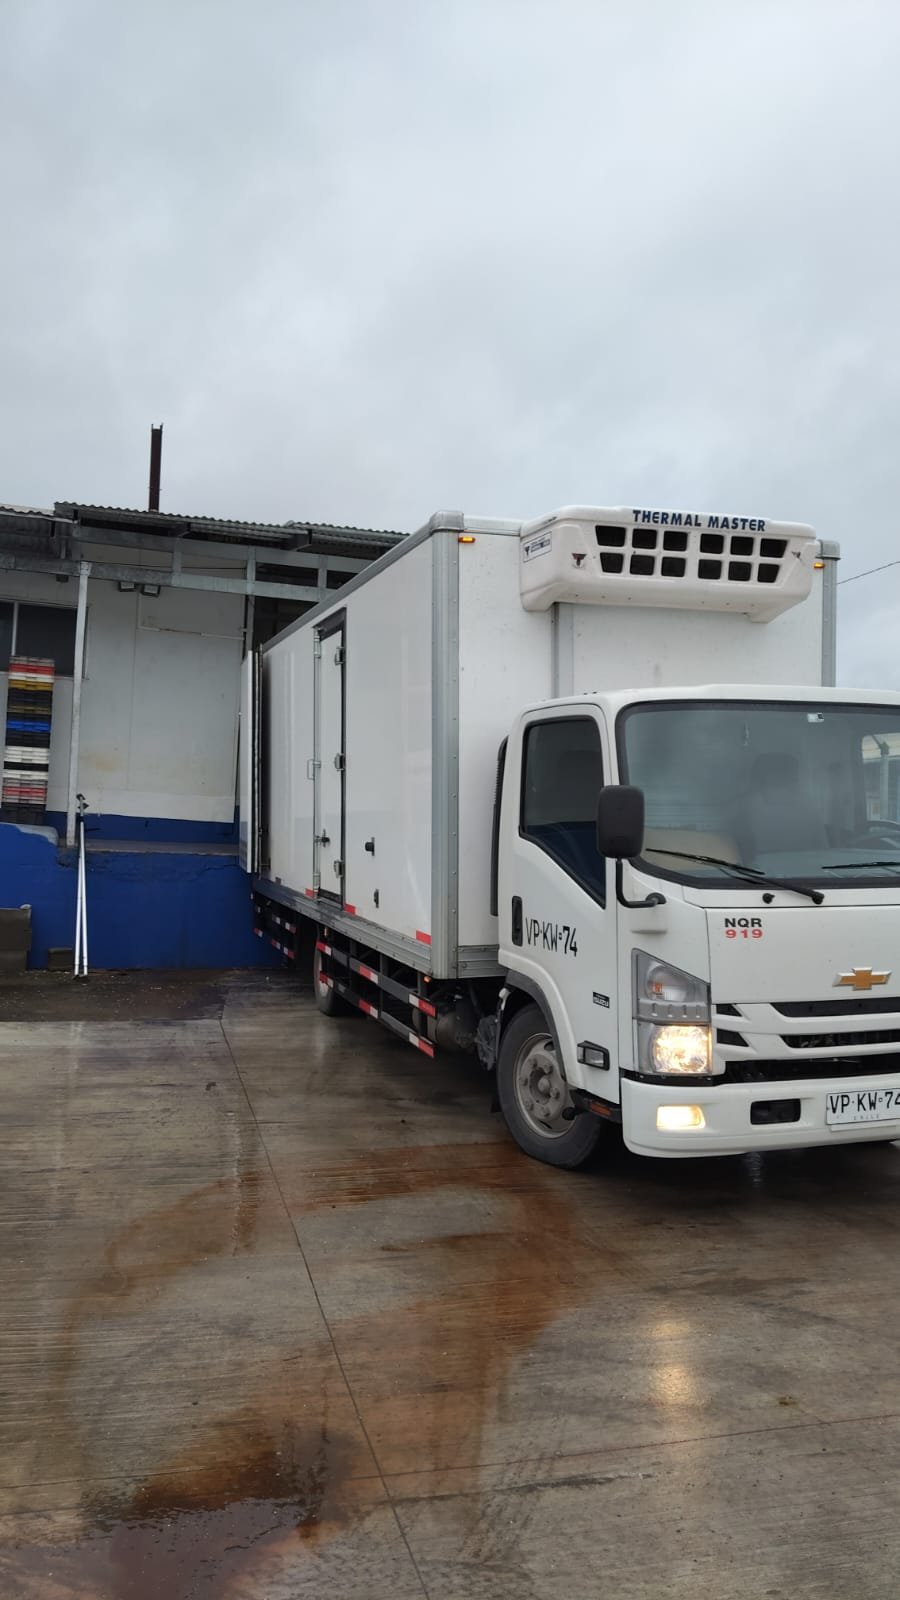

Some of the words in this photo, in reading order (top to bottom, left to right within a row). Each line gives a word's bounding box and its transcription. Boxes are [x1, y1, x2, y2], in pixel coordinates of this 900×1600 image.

[632, 509, 702, 527] THERMAL
[707, 515, 766, 532] MASTER
[724, 917, 763, 928] NQR
[725, 928, 763, 939] 919
